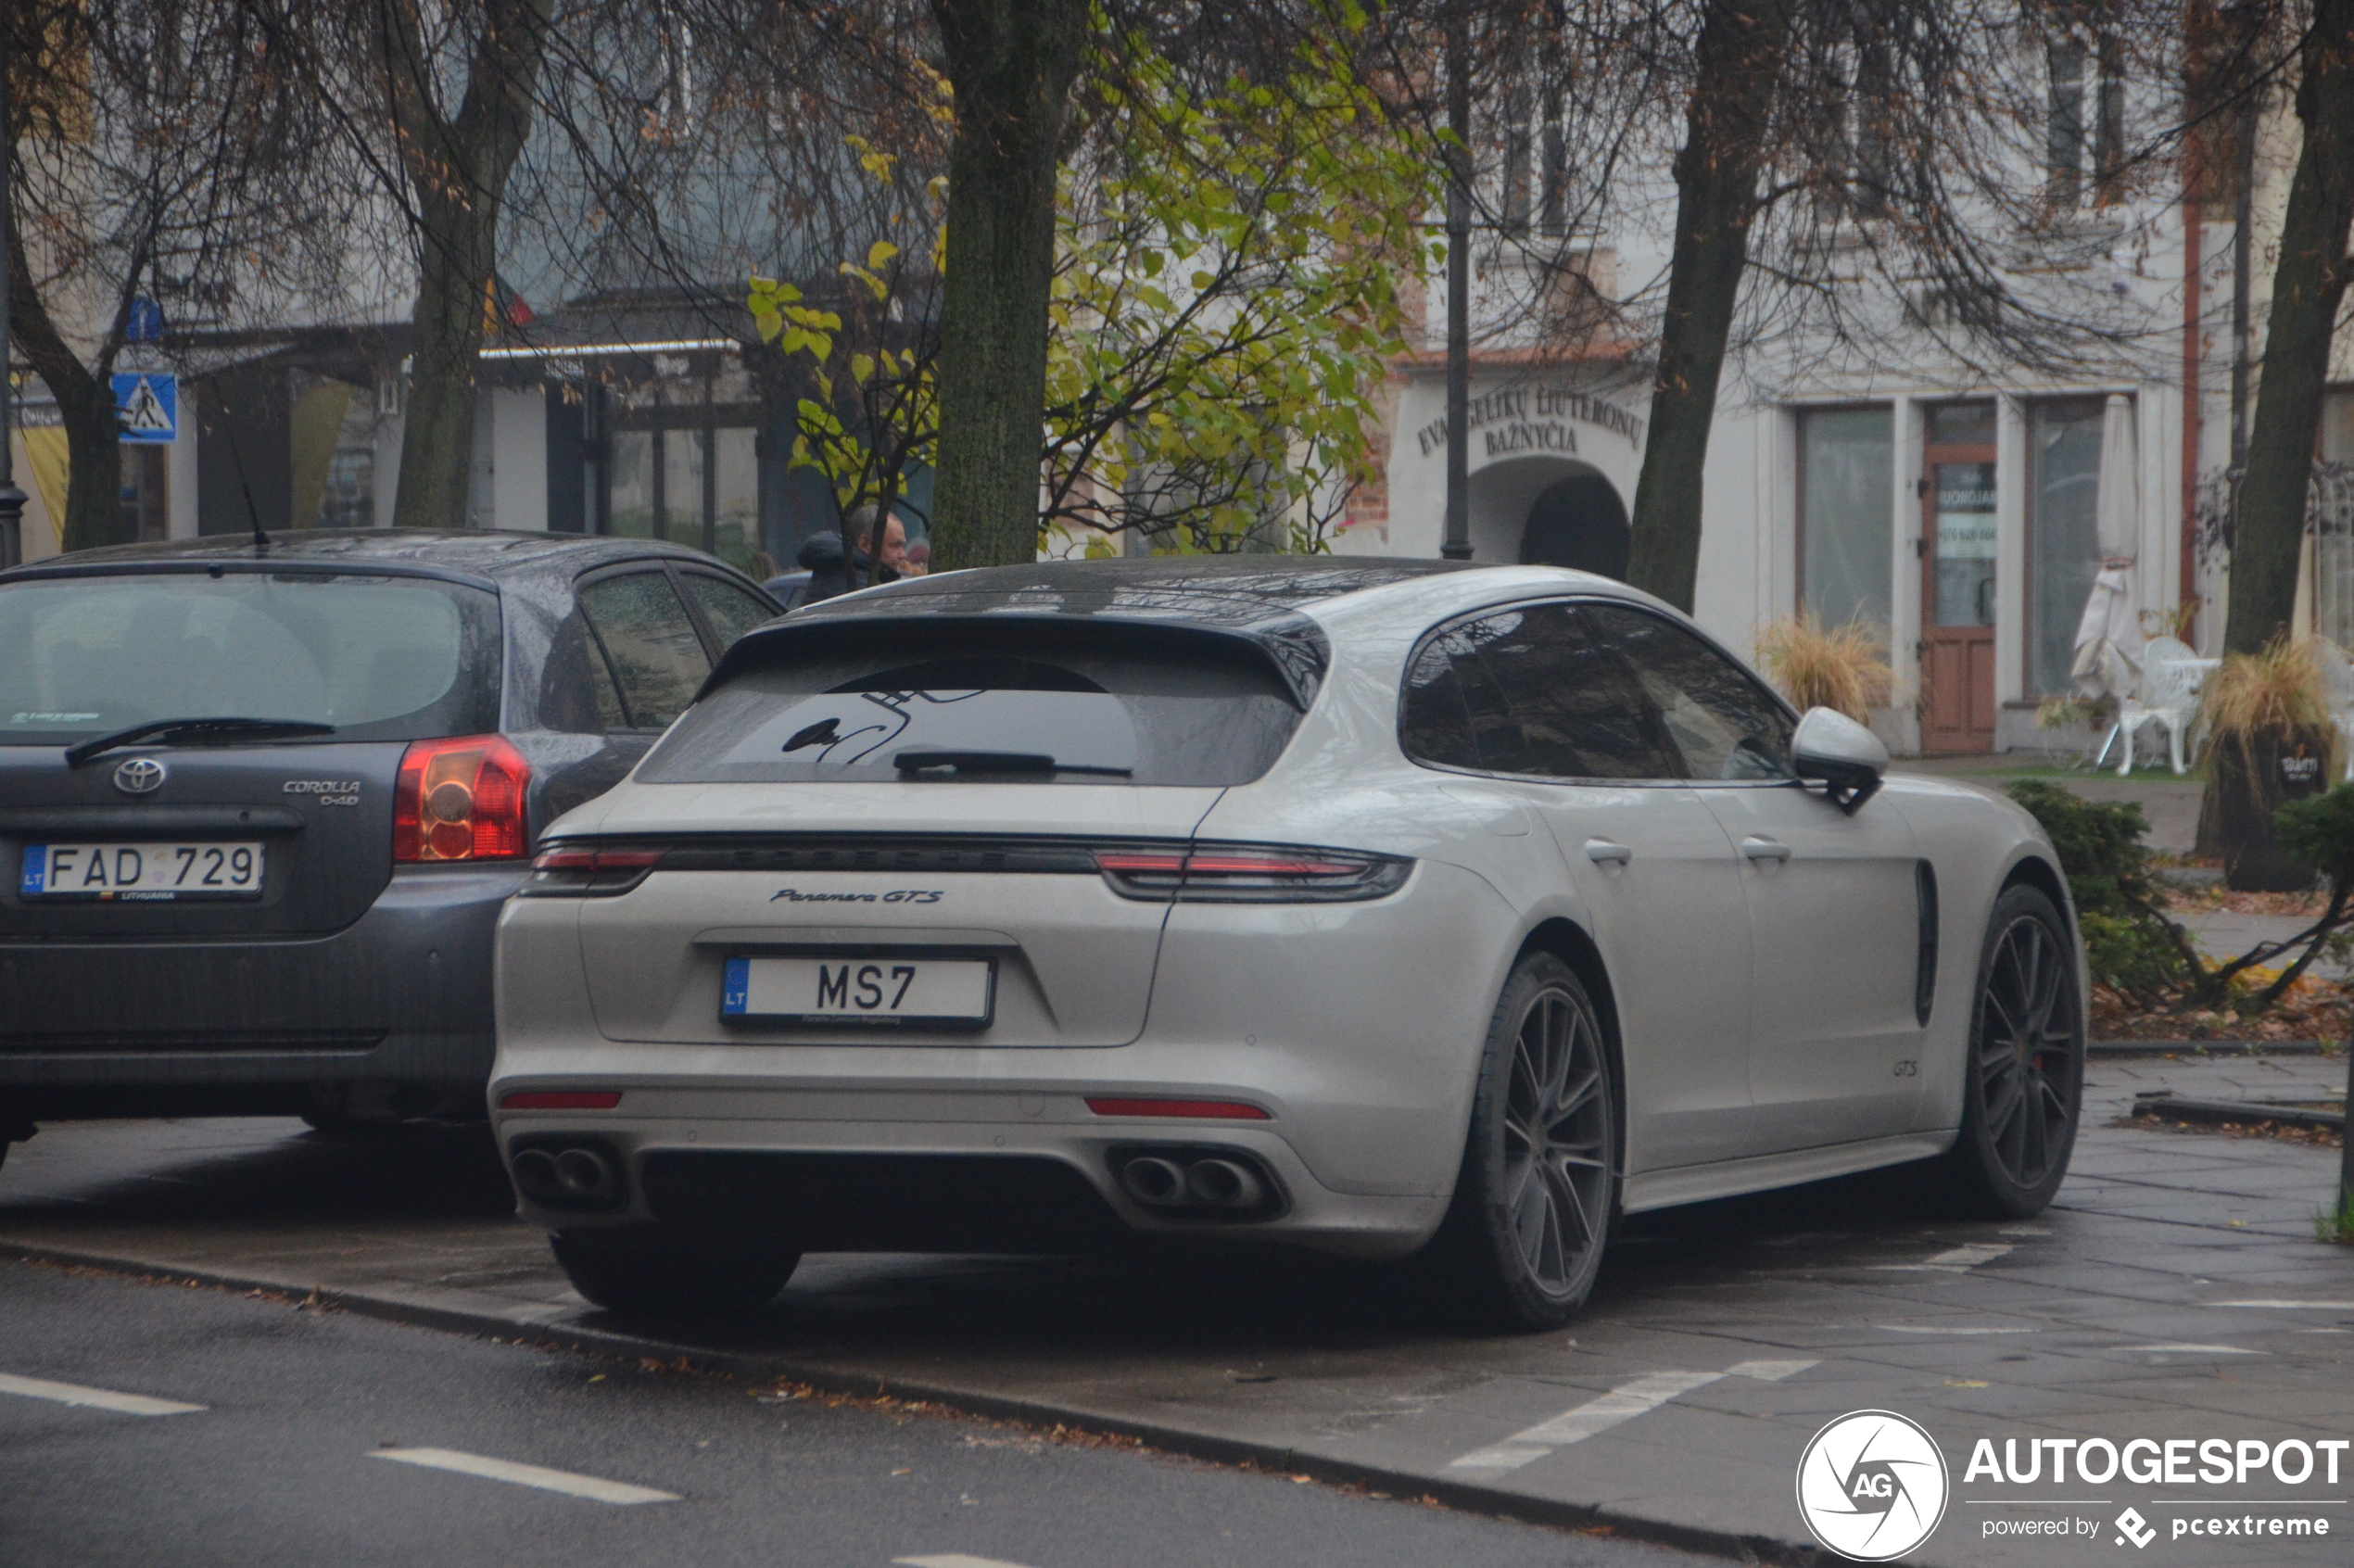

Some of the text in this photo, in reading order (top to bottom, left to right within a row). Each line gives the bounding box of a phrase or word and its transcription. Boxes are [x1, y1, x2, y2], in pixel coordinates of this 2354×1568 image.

[1418, 390, 1528, 456] EVAELIKŲ
[1486, 420, 1577, 456] BAŽNYČIA
[283, 780, 361, 793] COROLLA
[320, 795, 359, 805] D-4D
[49, 847, 253, 887] FAD 729
[24, 873, 44, 886] LT
[121, 891, 176, 901] LITHUANIA
[769, 888, 945, 904] Panamera GTS
[816, 964, 917, 1010] MS7
[726, 992, 745, 1005] LT
[1893, 1060, 1918, 1077] GTS
